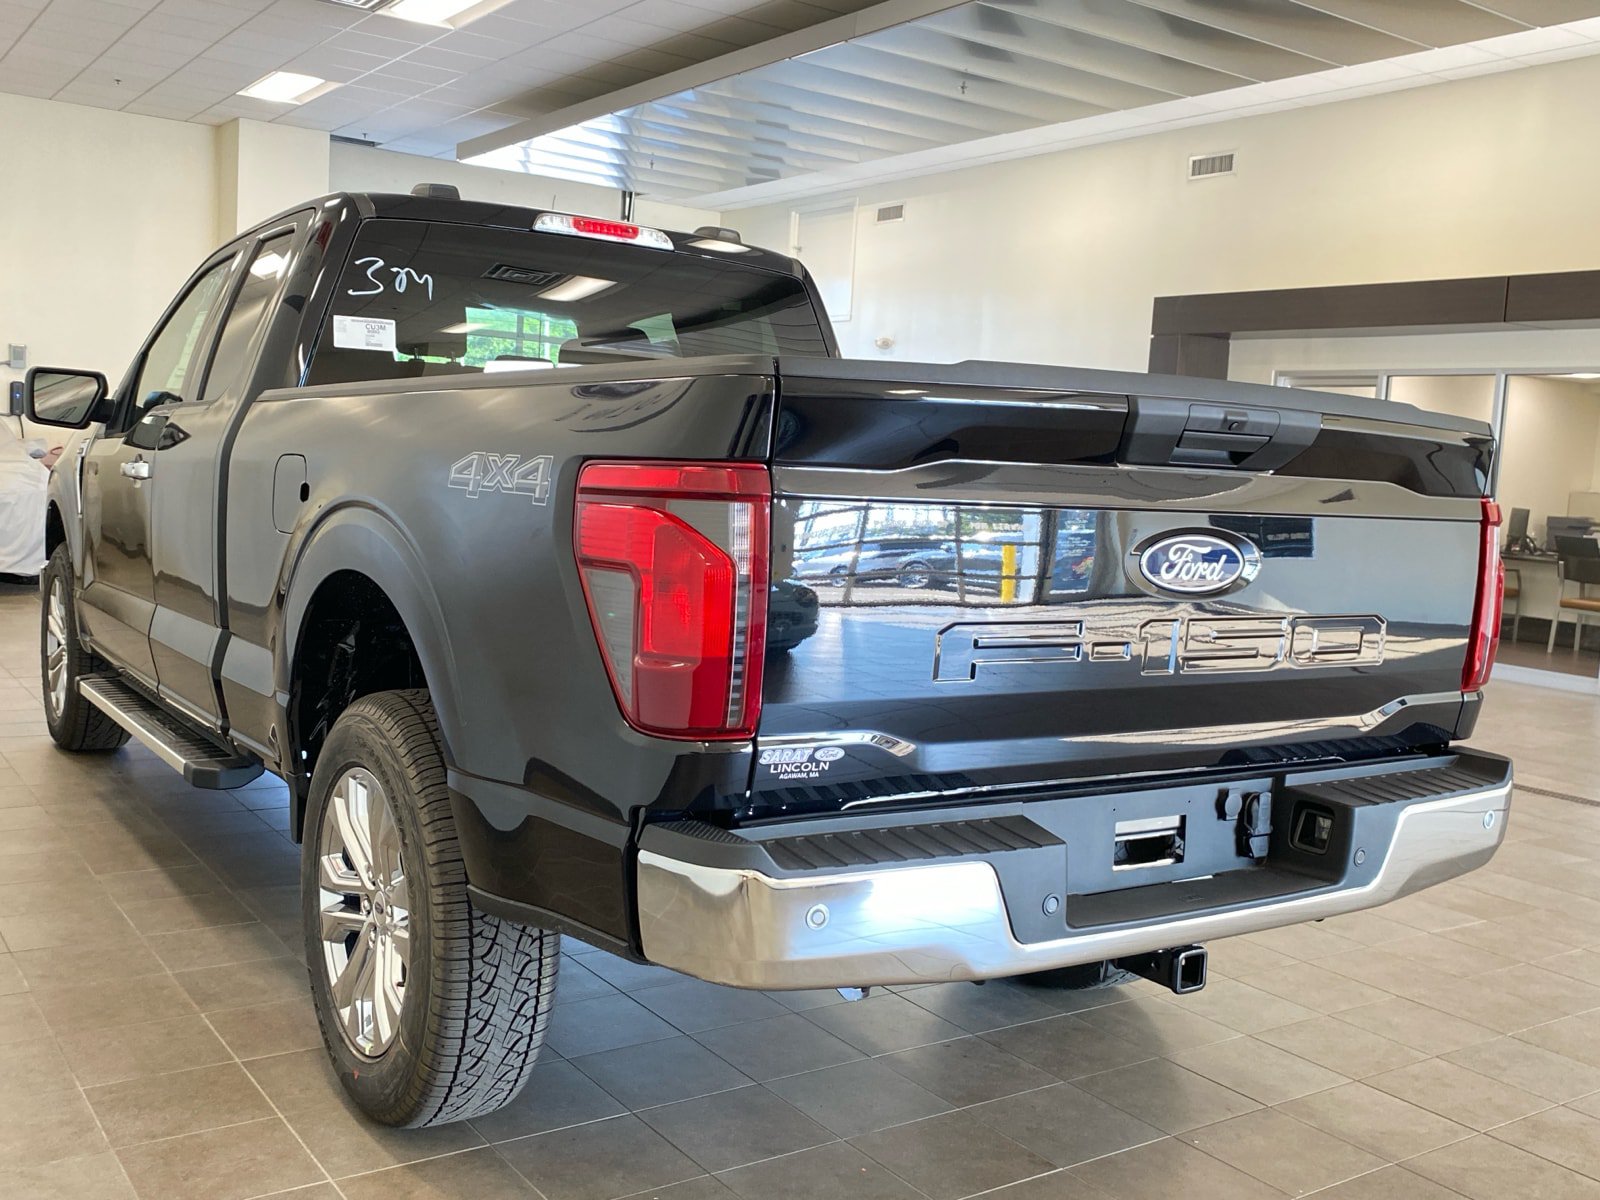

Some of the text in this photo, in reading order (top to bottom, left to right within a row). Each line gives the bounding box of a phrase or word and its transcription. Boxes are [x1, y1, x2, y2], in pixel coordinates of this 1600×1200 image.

[1160, 543, 1225, 581] Ford
[932, 613, 1388, 683] F-150
[759, 747, 814, 764] SARAT
[769, 761, 830, 774] LINCOLN
[779, 772, 809, 780] AGAWAM,
